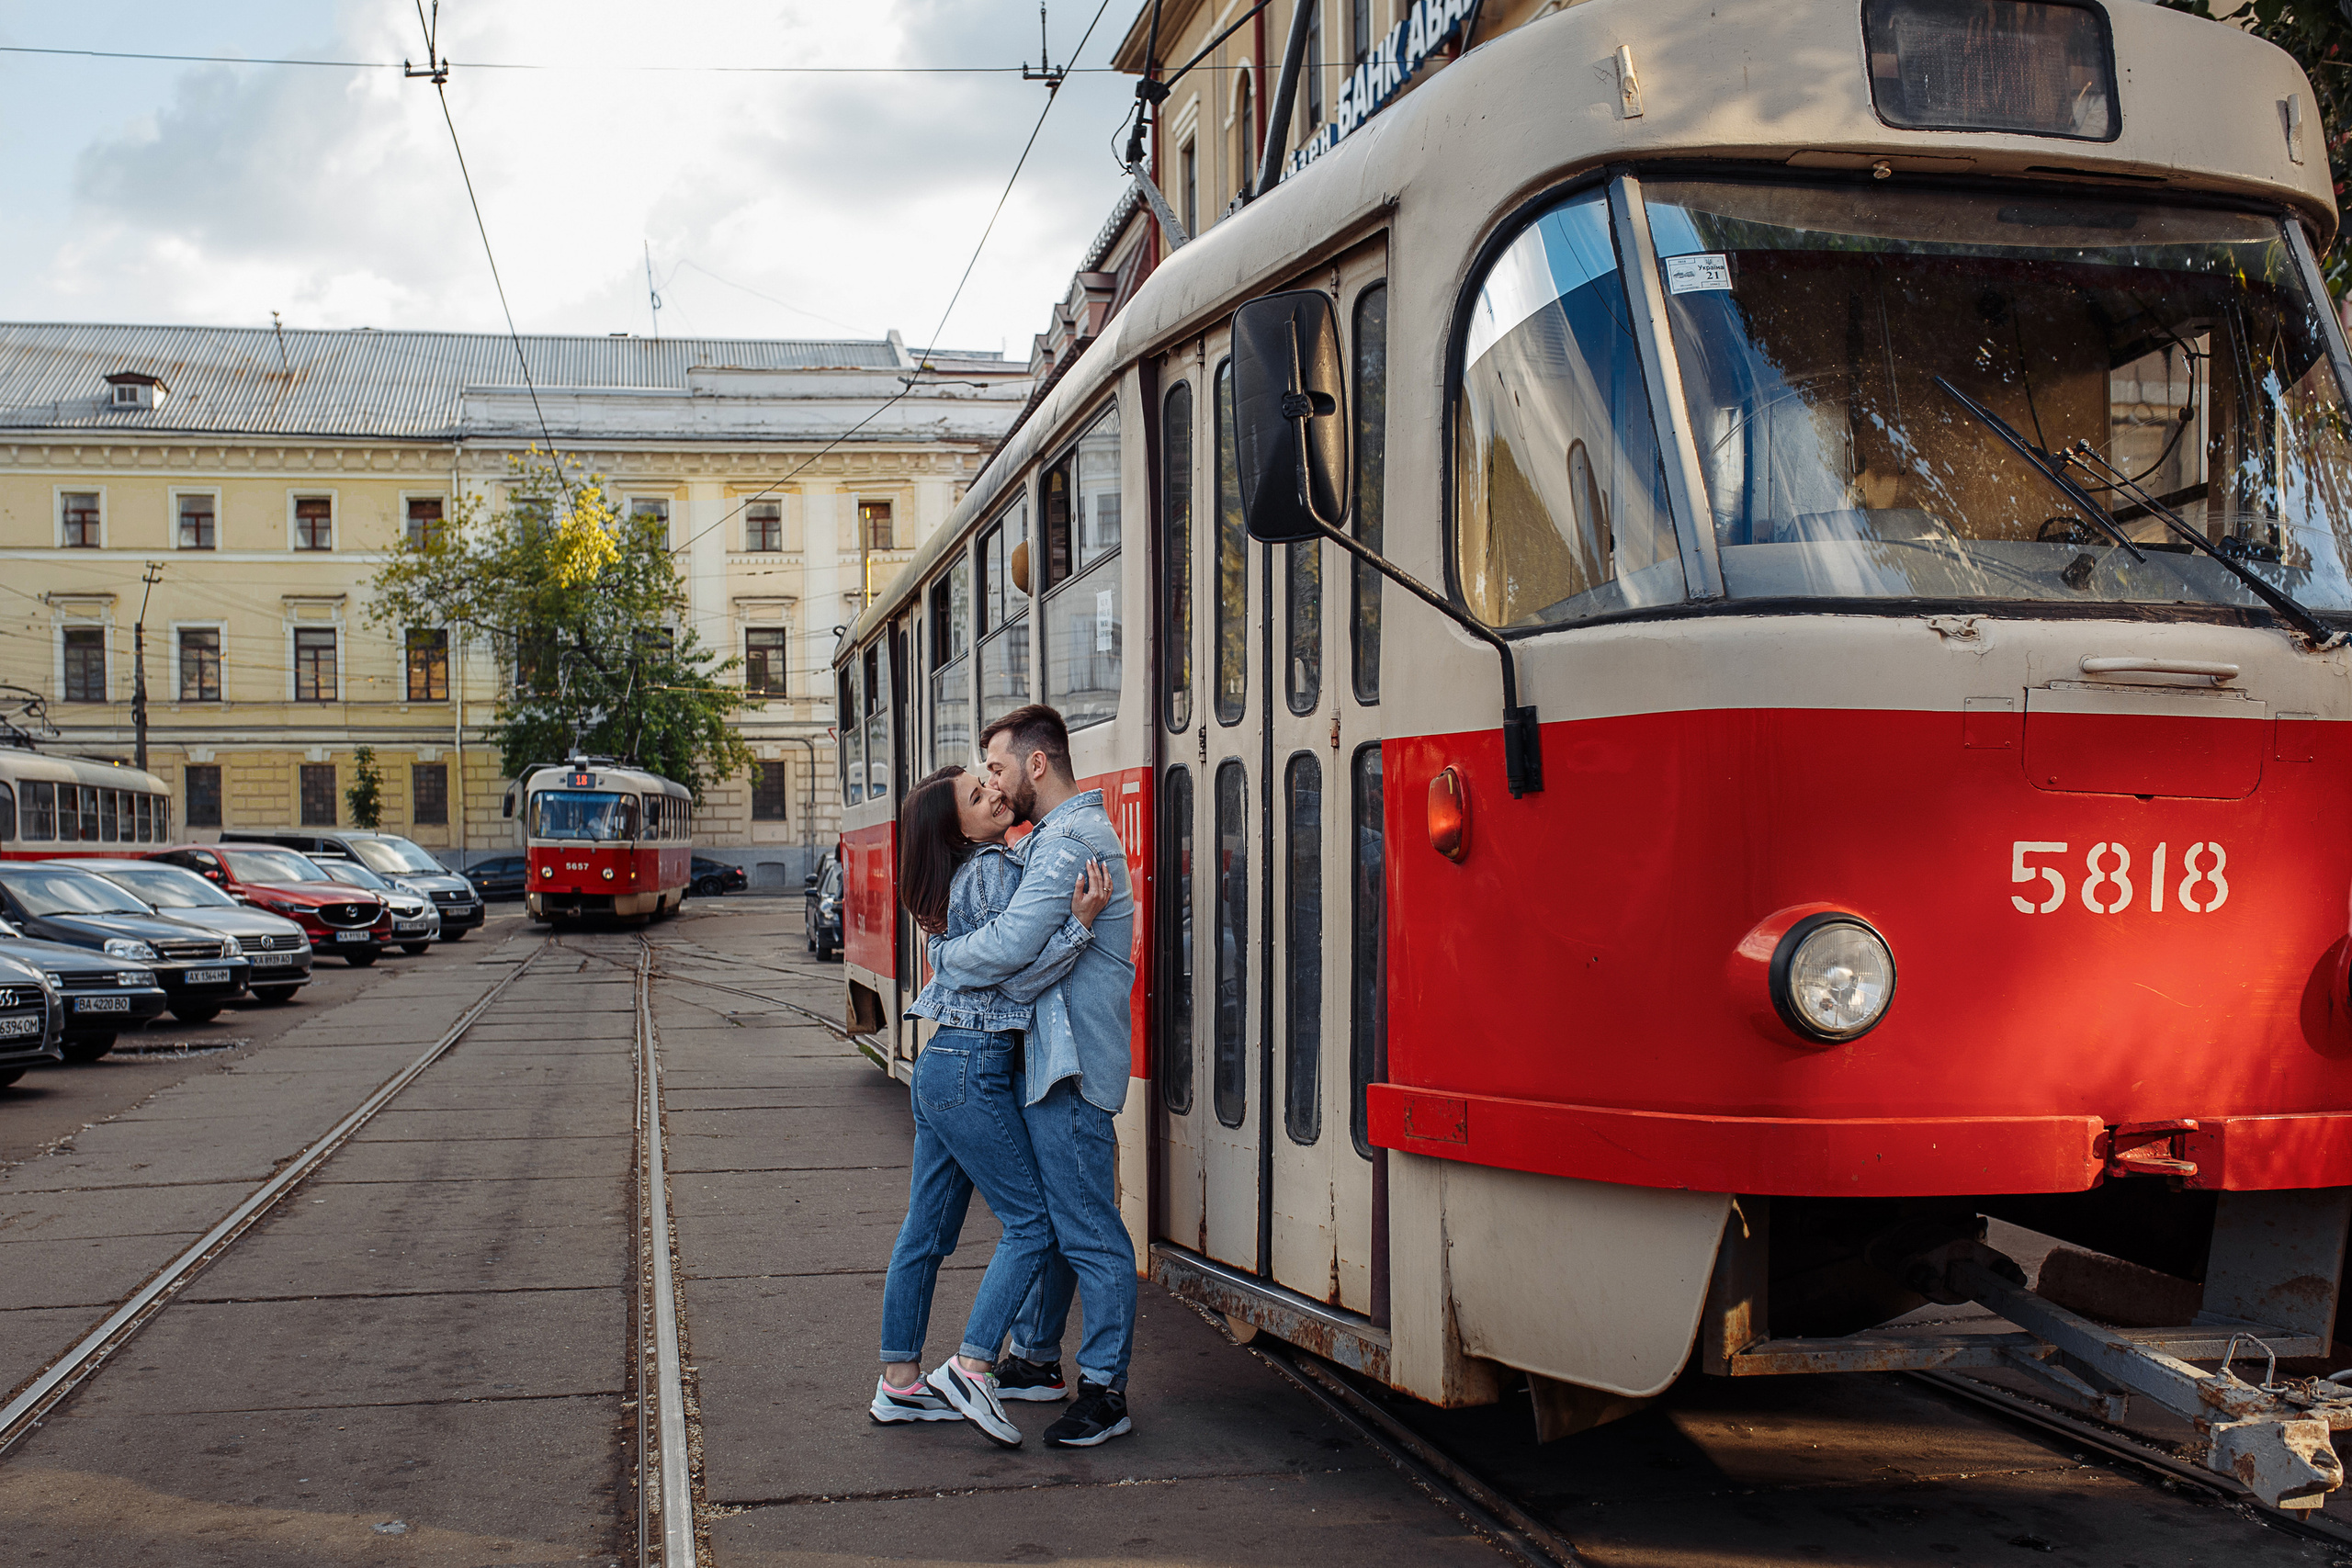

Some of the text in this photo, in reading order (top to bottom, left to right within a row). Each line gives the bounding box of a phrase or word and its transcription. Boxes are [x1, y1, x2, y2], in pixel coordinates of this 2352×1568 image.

[1338, 20, 1402, 141] БАНК
[1406, 0, 1473, 72] АВА
[1706, 271, 1719, 279] 21
[575, 774, 588, 785] 18
[566, 862, 589, 871] 5657
[2011, 841, 2229, 914] 5818
[94, 998, 113, 1010] 4220
[0, 1019, 37, 1034] 6394 OM
